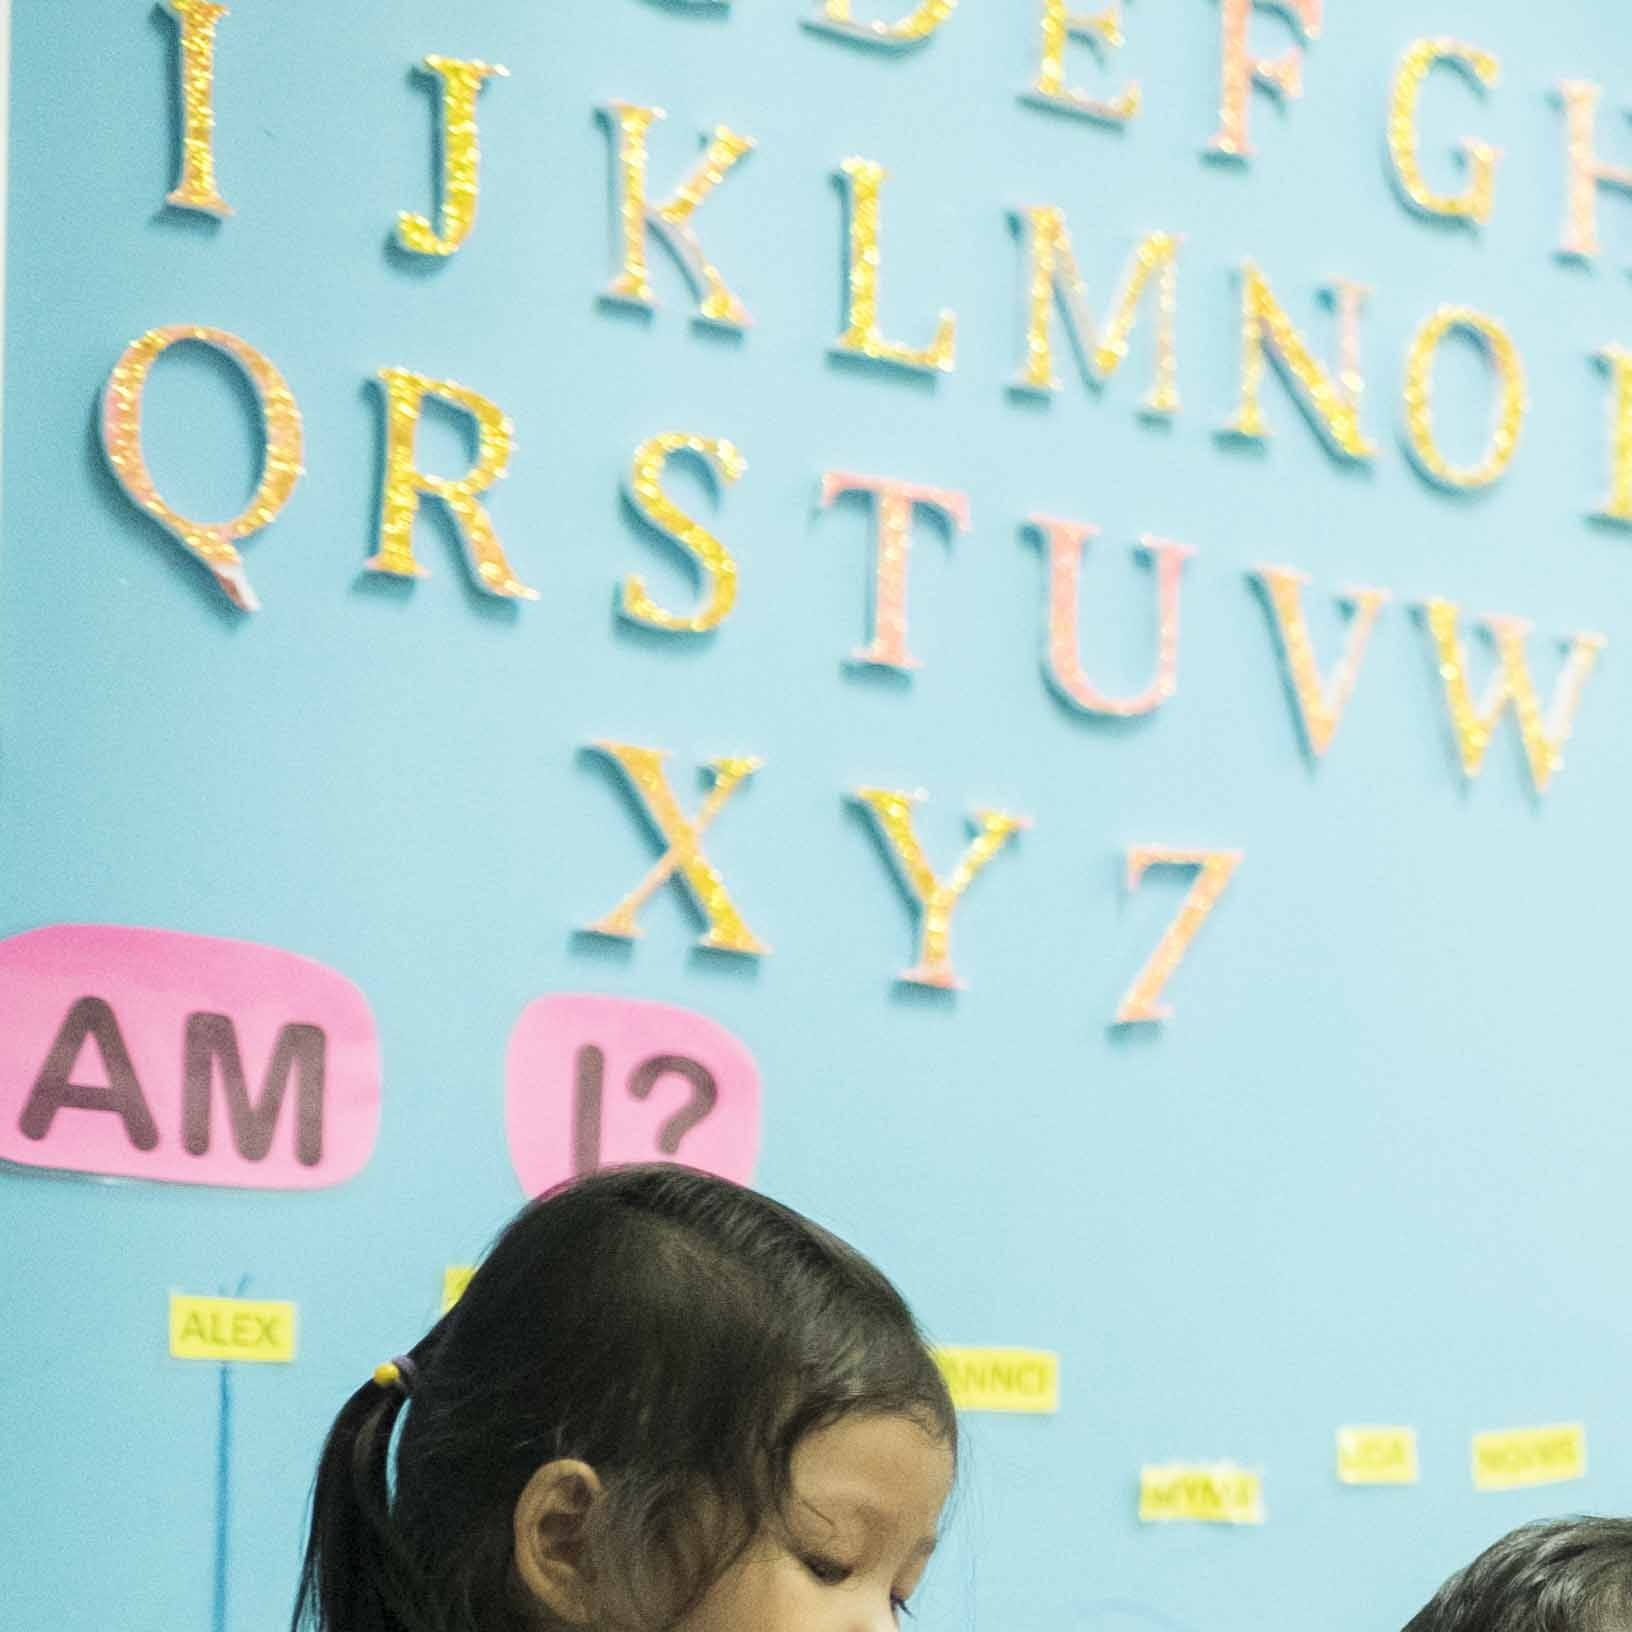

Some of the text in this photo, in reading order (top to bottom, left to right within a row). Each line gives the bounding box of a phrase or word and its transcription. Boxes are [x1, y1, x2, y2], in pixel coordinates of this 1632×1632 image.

[1032, 0, 1142, 120] E
[1210, 0, 1323, 155] F
[1388, 38, 1503, 224] G
[398, 56, 510, 255] J
[609, 98, 756, 326] K
[838, 157, 957, 371] L
[1019, 204, 1184, 413] M
[1227, 259, 1382, 457] N
[1401, 305, 1529, 487] O
[104, 324, 1606, 792] Q R S T U V W
[588, 738, 770, 955] X
[855, 785, 1031, 989] Y
[18, 995, 327, 1168] AM
[180, 1310, 282, 1348] ALEX
